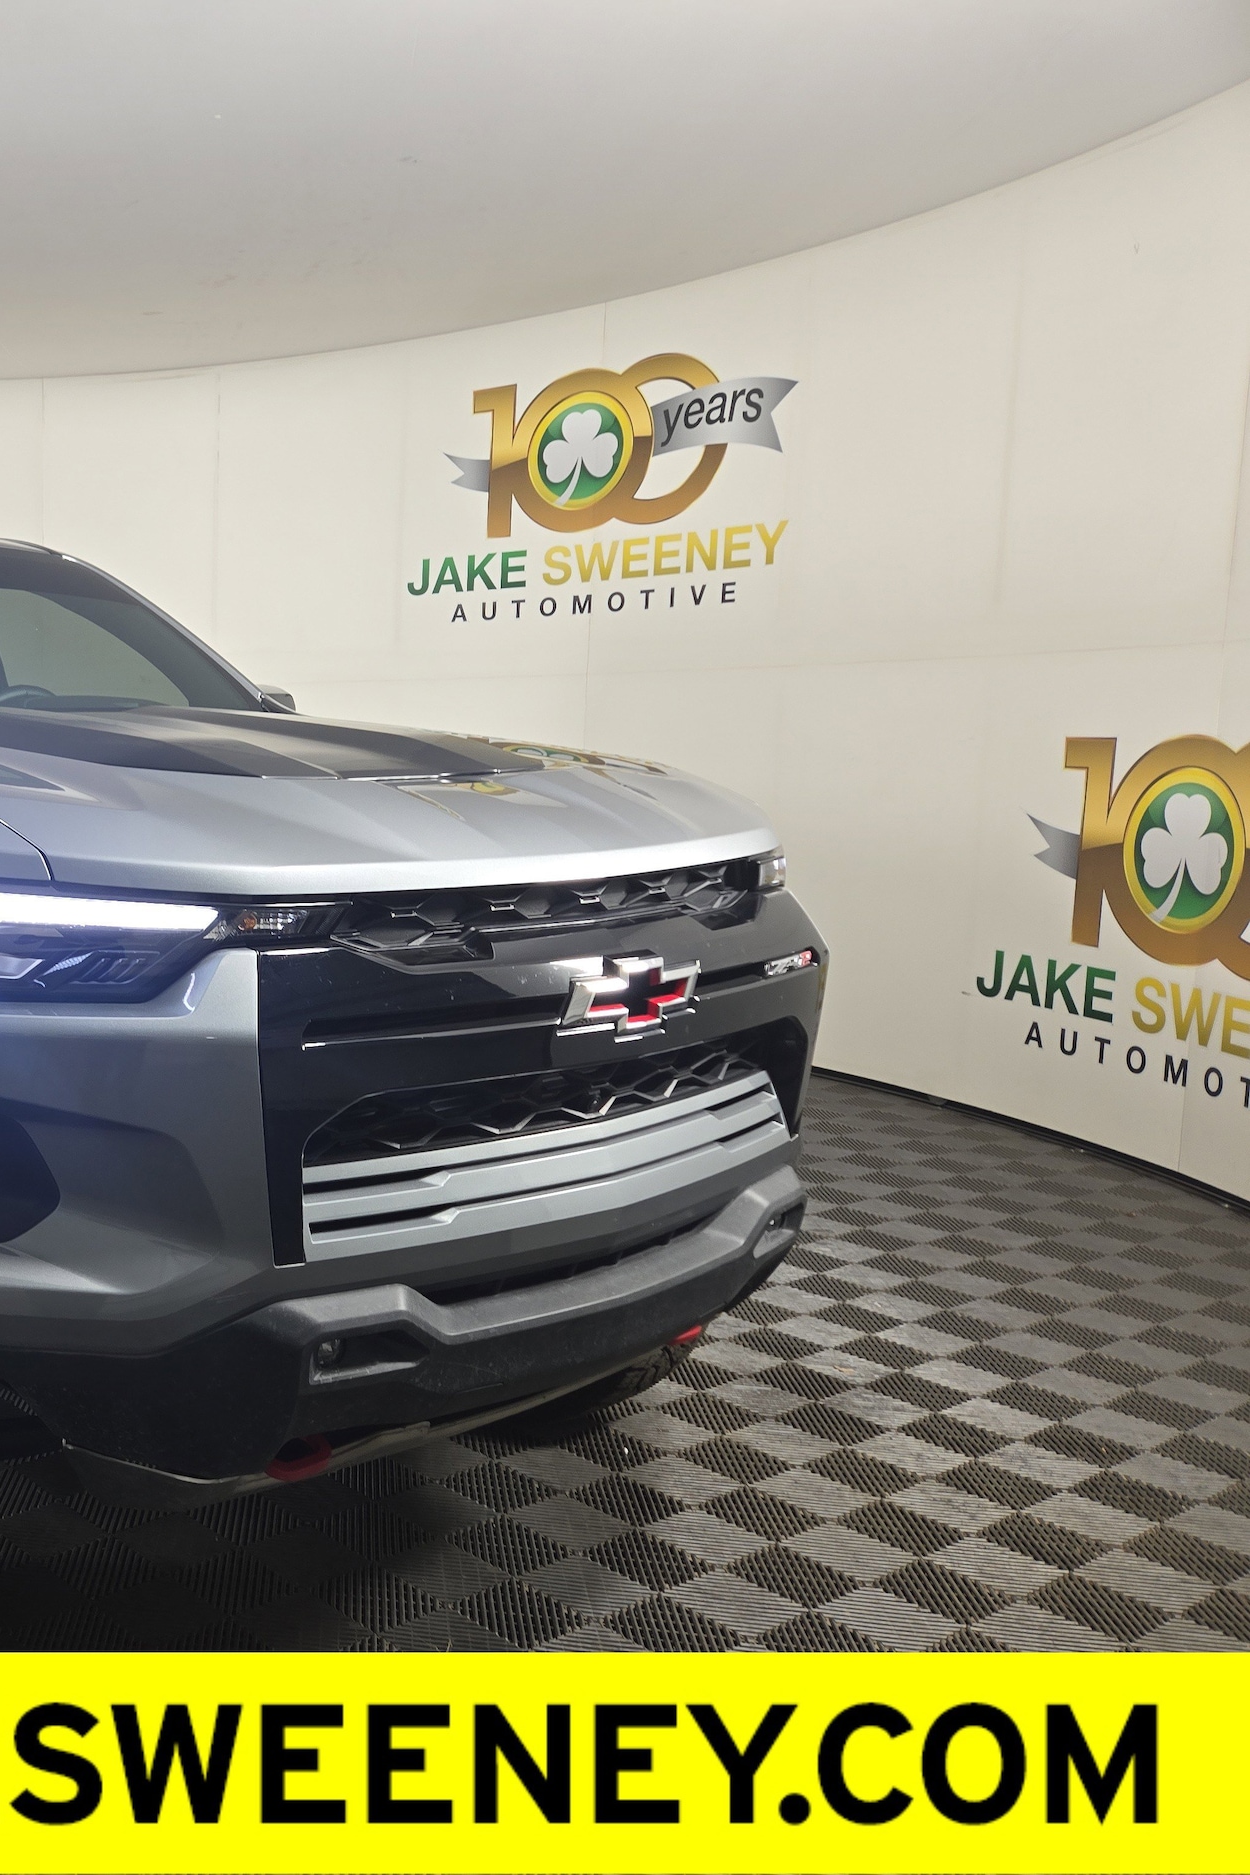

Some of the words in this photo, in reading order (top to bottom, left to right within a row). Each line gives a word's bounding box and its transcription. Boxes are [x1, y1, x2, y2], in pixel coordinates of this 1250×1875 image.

[472, 352, 728, 539] 100
[660, 387, 765, 448] years
[406, 549, 528, 597] JAKE
[541, 519, 790, 587] SWEENEY
[450, 581, 738, 623] AUTOMOTIVE
[976, 949, 1117, 1024] JAKE
